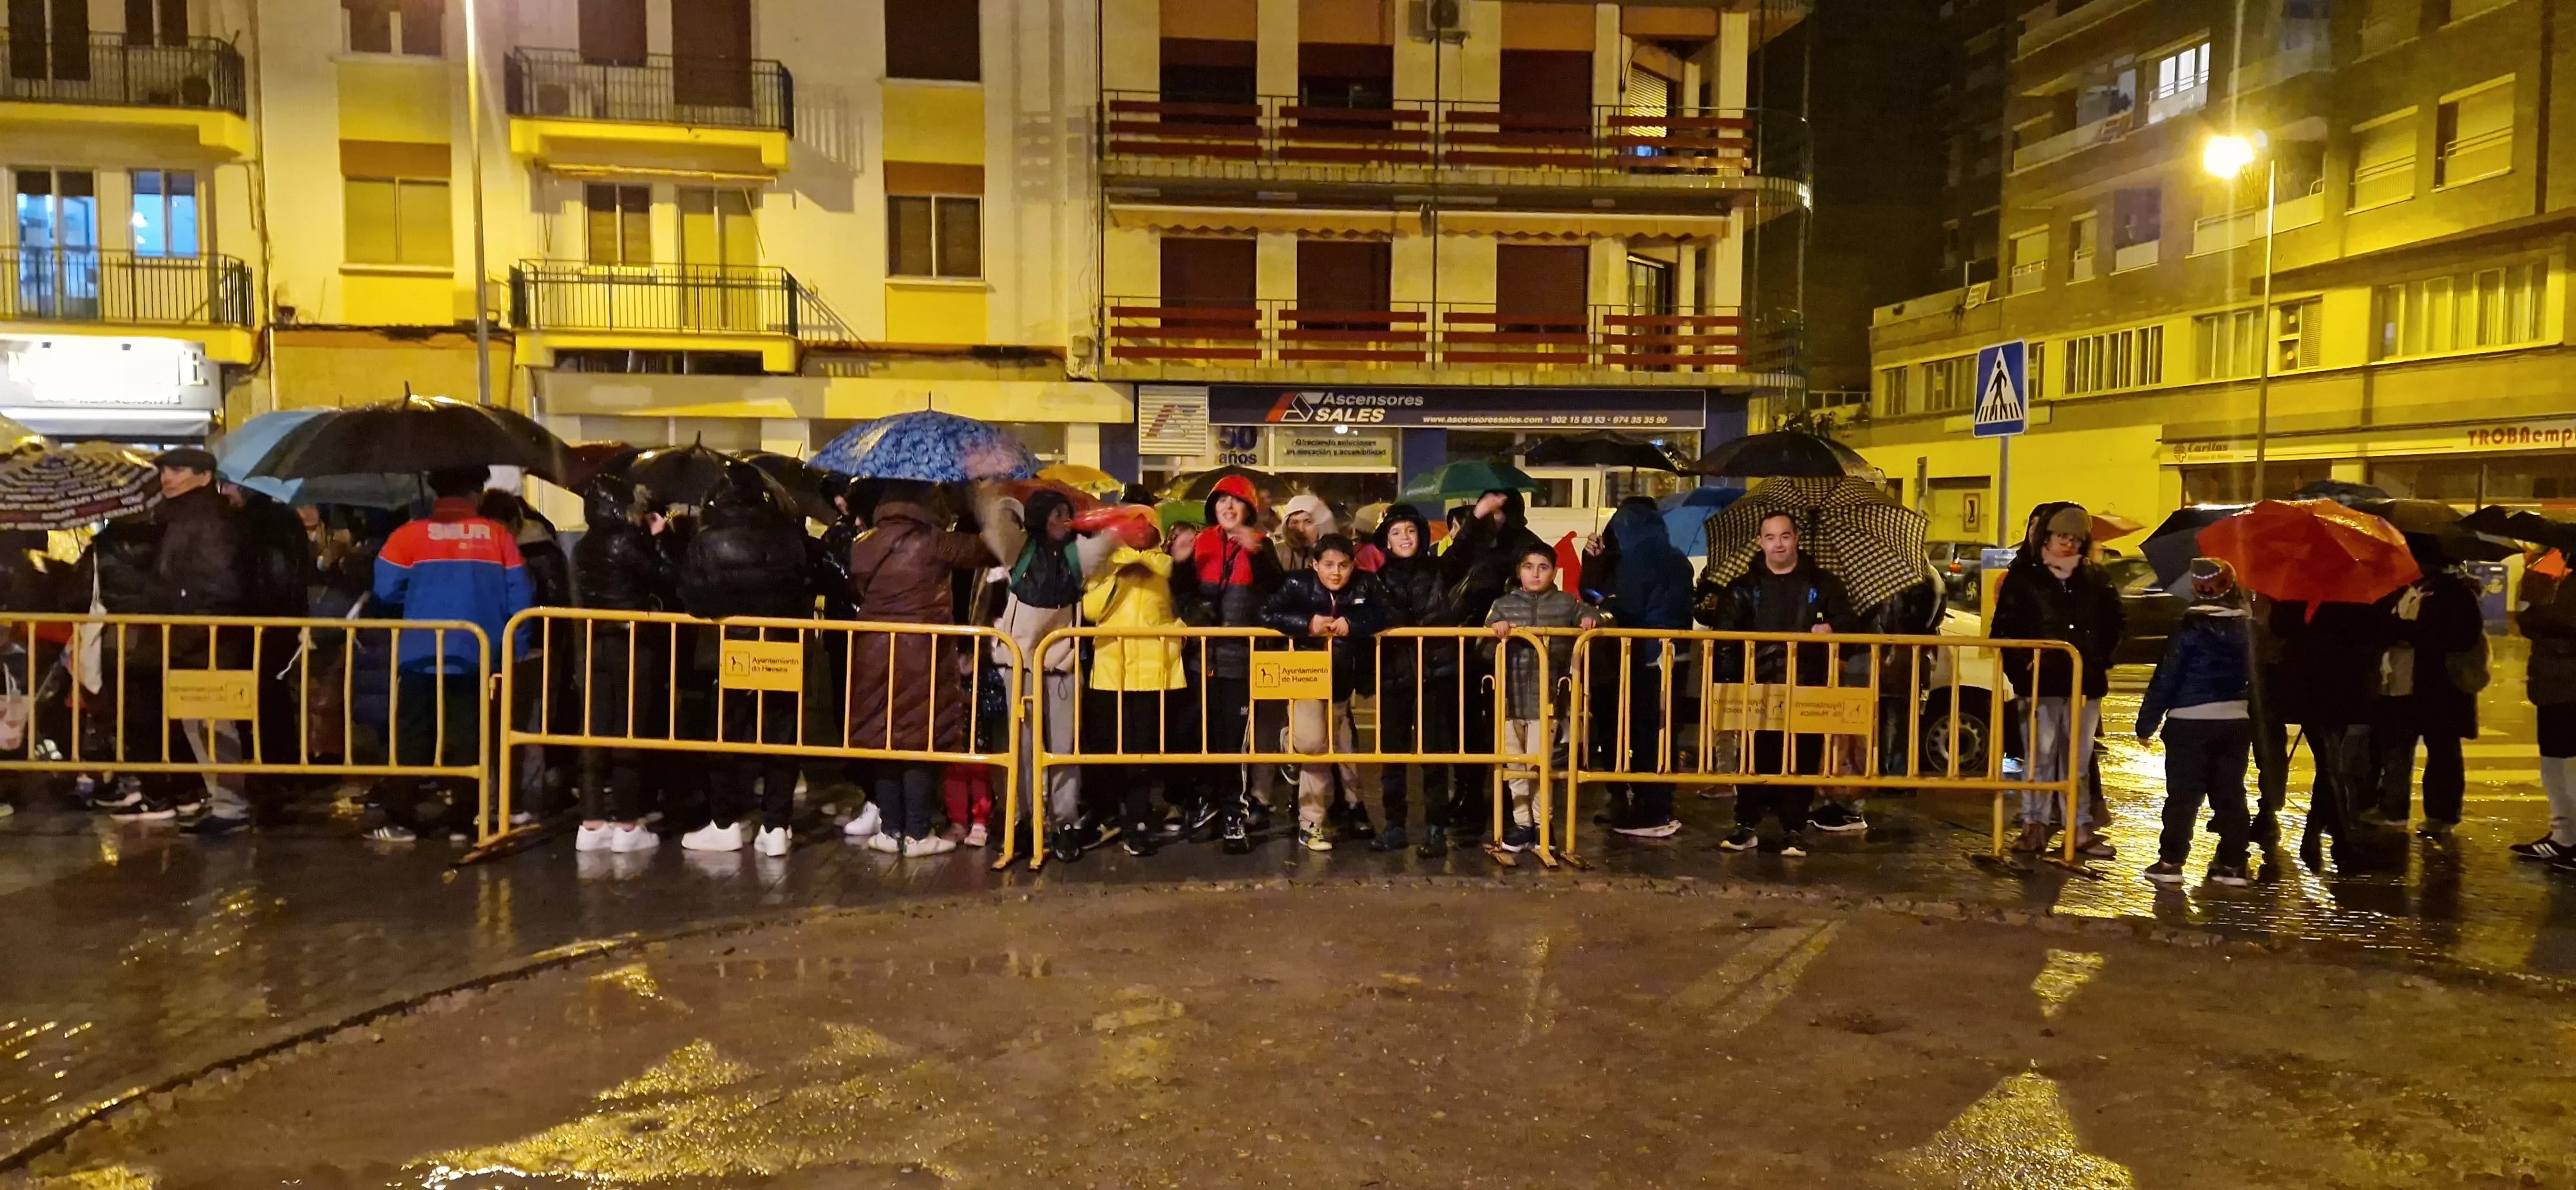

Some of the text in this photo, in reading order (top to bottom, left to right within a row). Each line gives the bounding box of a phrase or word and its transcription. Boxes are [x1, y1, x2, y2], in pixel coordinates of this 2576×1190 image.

[1322, 392, 1424, 406] Ascensores
[1315, 407, 1386, 423] SALES
[1218, 426, 1258, 450] 50
[1219, 450, 1257, 464] años
[752, 656, 799, 665] Ayuntamiento
